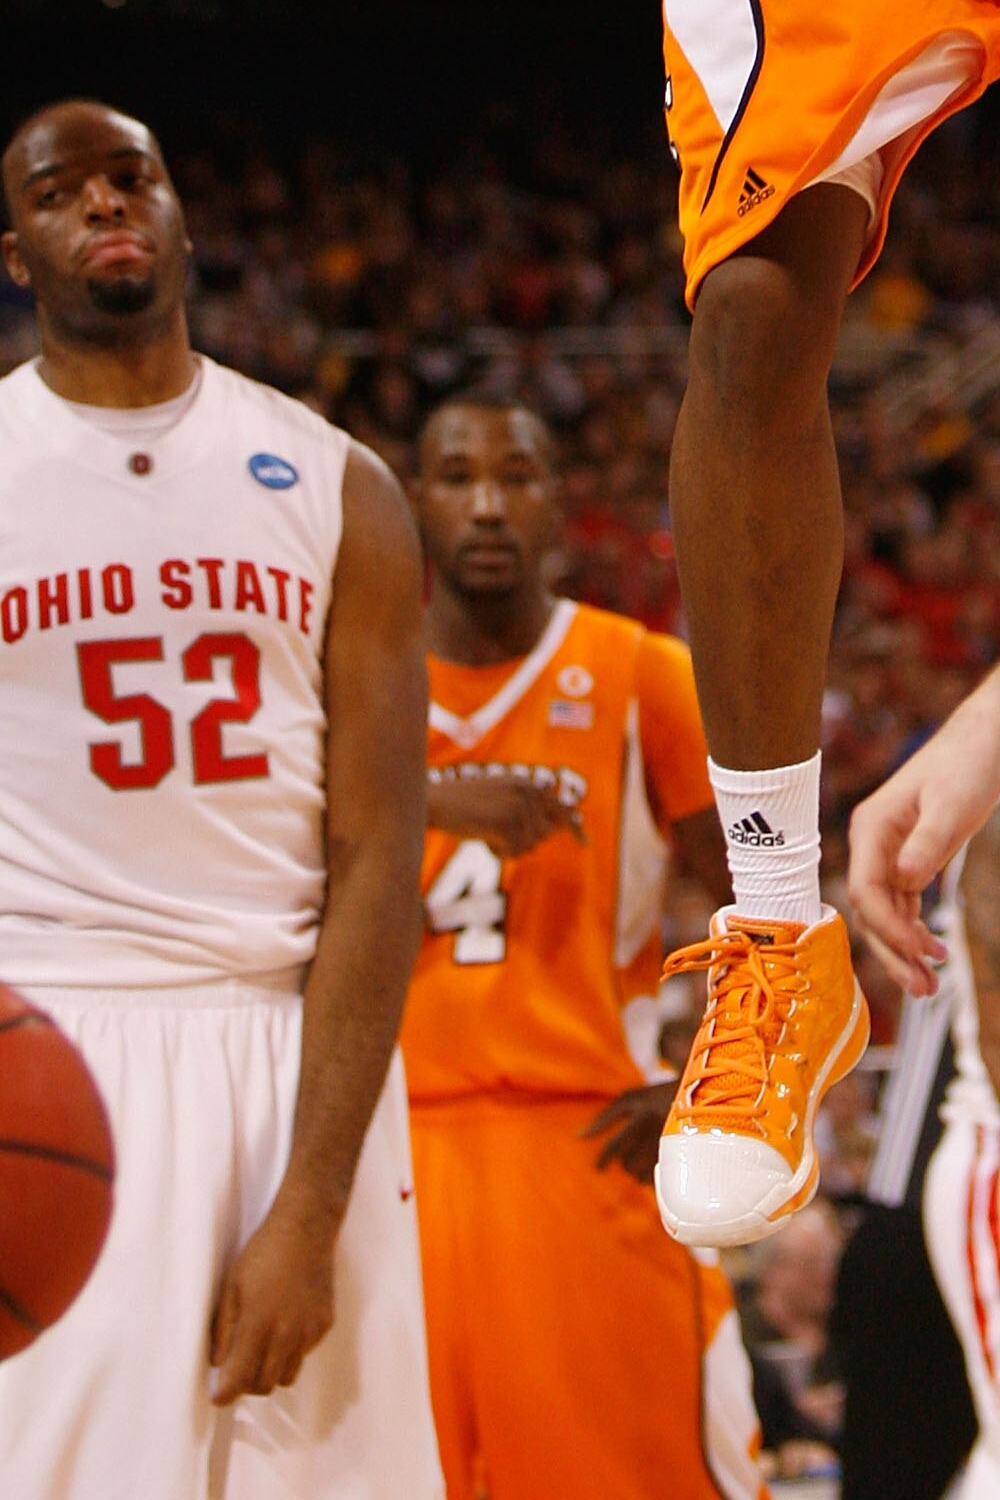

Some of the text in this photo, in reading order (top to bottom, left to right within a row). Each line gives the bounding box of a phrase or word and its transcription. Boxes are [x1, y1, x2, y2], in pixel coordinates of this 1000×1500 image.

[737, 185, 775, 218] adidas
[0, 558, 314, 644] OHIO STATE
[76, 631, 270, 792] 52
[728, 828, 785, 846] adidas
[426, 838, 507, 964] 4
